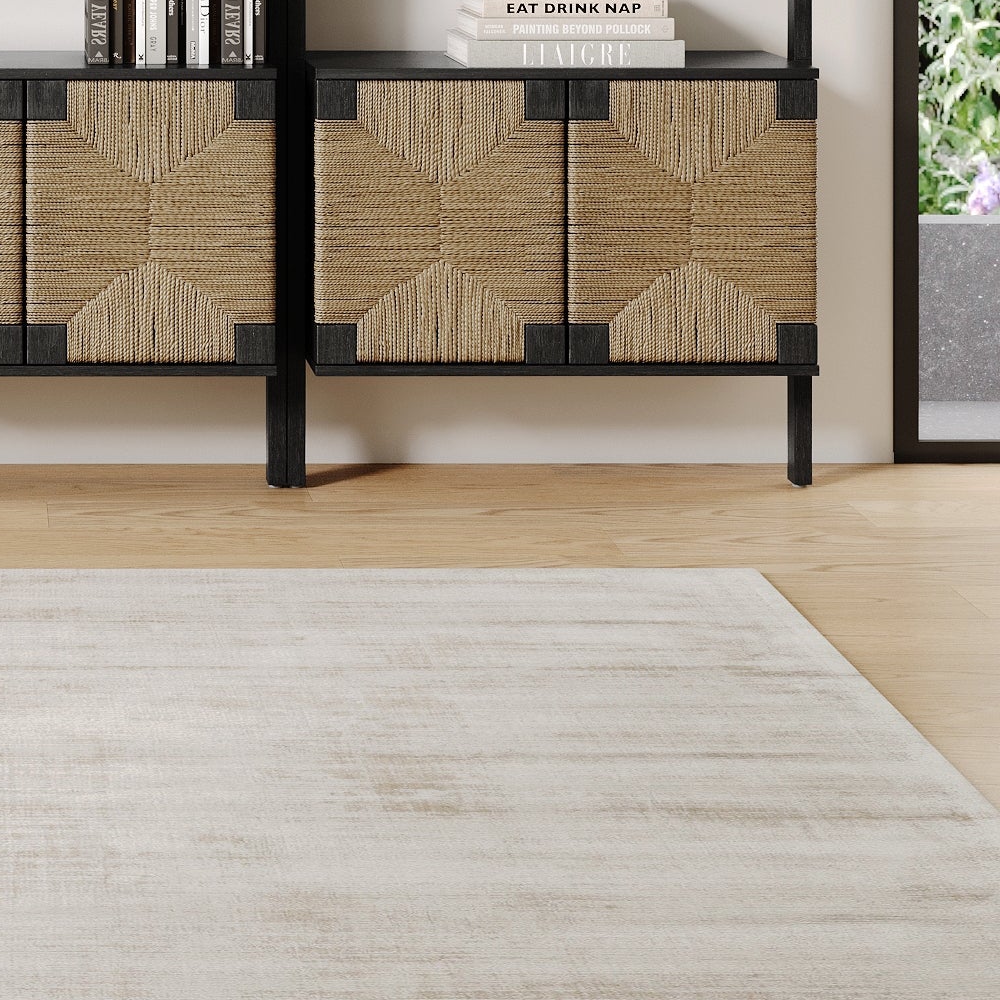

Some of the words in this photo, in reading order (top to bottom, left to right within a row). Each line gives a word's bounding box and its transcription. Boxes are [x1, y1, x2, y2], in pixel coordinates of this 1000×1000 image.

[507, 3, 539, 14] EAT
[544, 3, 600, 14] DRINK
[605, 3, 641, 14] NAP
[200, 5, 210, 34] Dior
[513, 23, 560, 35] PAINTING
[562, 23, 602, 35] BEYOND
[605, 23, 651, 35] POLLOCK
[522, 43, 632, 66] LIAIGRE
